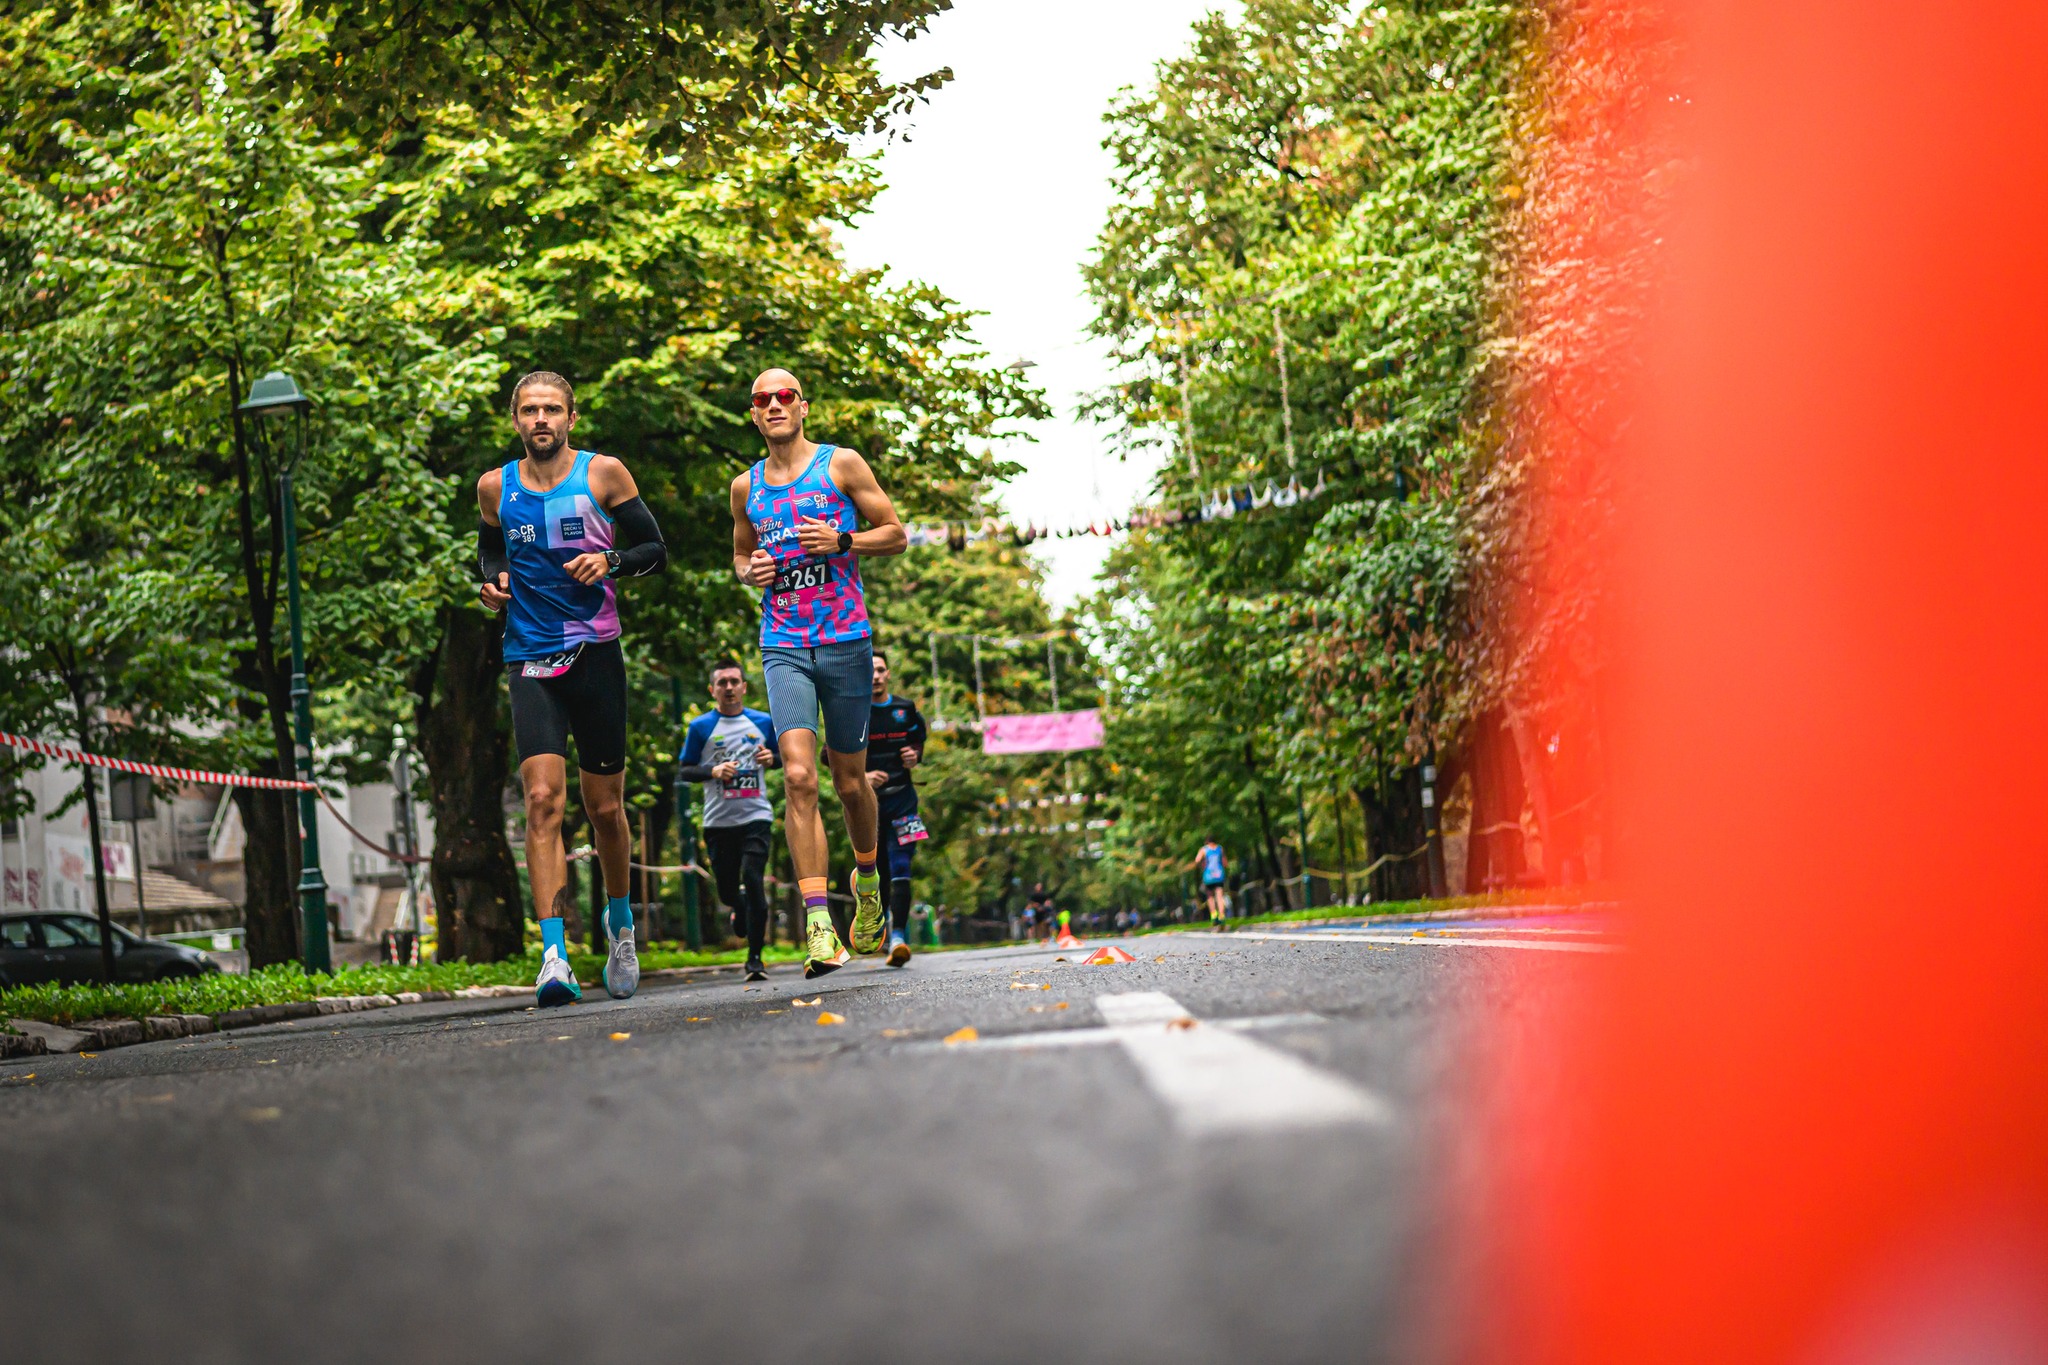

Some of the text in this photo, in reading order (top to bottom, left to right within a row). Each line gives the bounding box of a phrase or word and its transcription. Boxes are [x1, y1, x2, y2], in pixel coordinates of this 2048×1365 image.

[814, 494, 827, 503] CR
[520, 524, 534, 535] CR
[521, 532, 536, 543] 387
[791, 563, 826, 590] 267
[777, 595, 788, 607] 6H
[526, 666, 540, 676] 6H
[738, 776, 757, 789] 221
